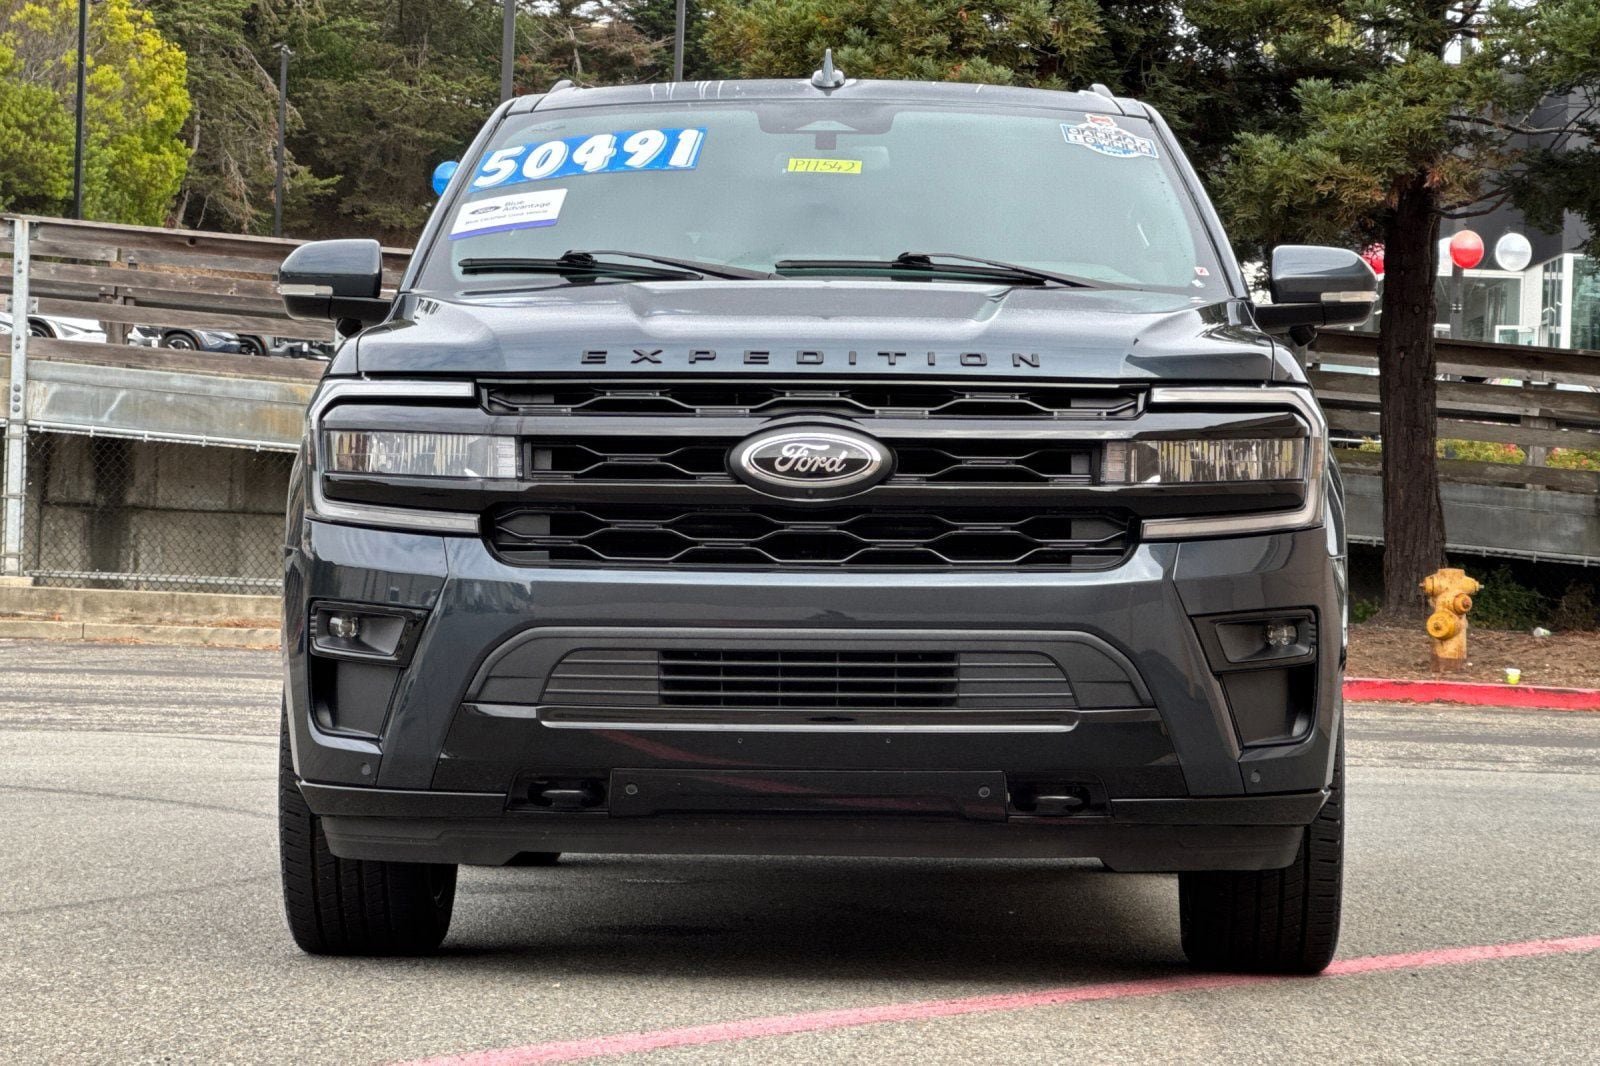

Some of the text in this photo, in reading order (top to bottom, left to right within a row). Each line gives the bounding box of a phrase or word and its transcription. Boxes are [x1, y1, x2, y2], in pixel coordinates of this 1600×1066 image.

[473, 129, 704, 188] 50491
[580, 349, 1041, 368] EXPEDITION
[774, 443, 847, 473] Ford
